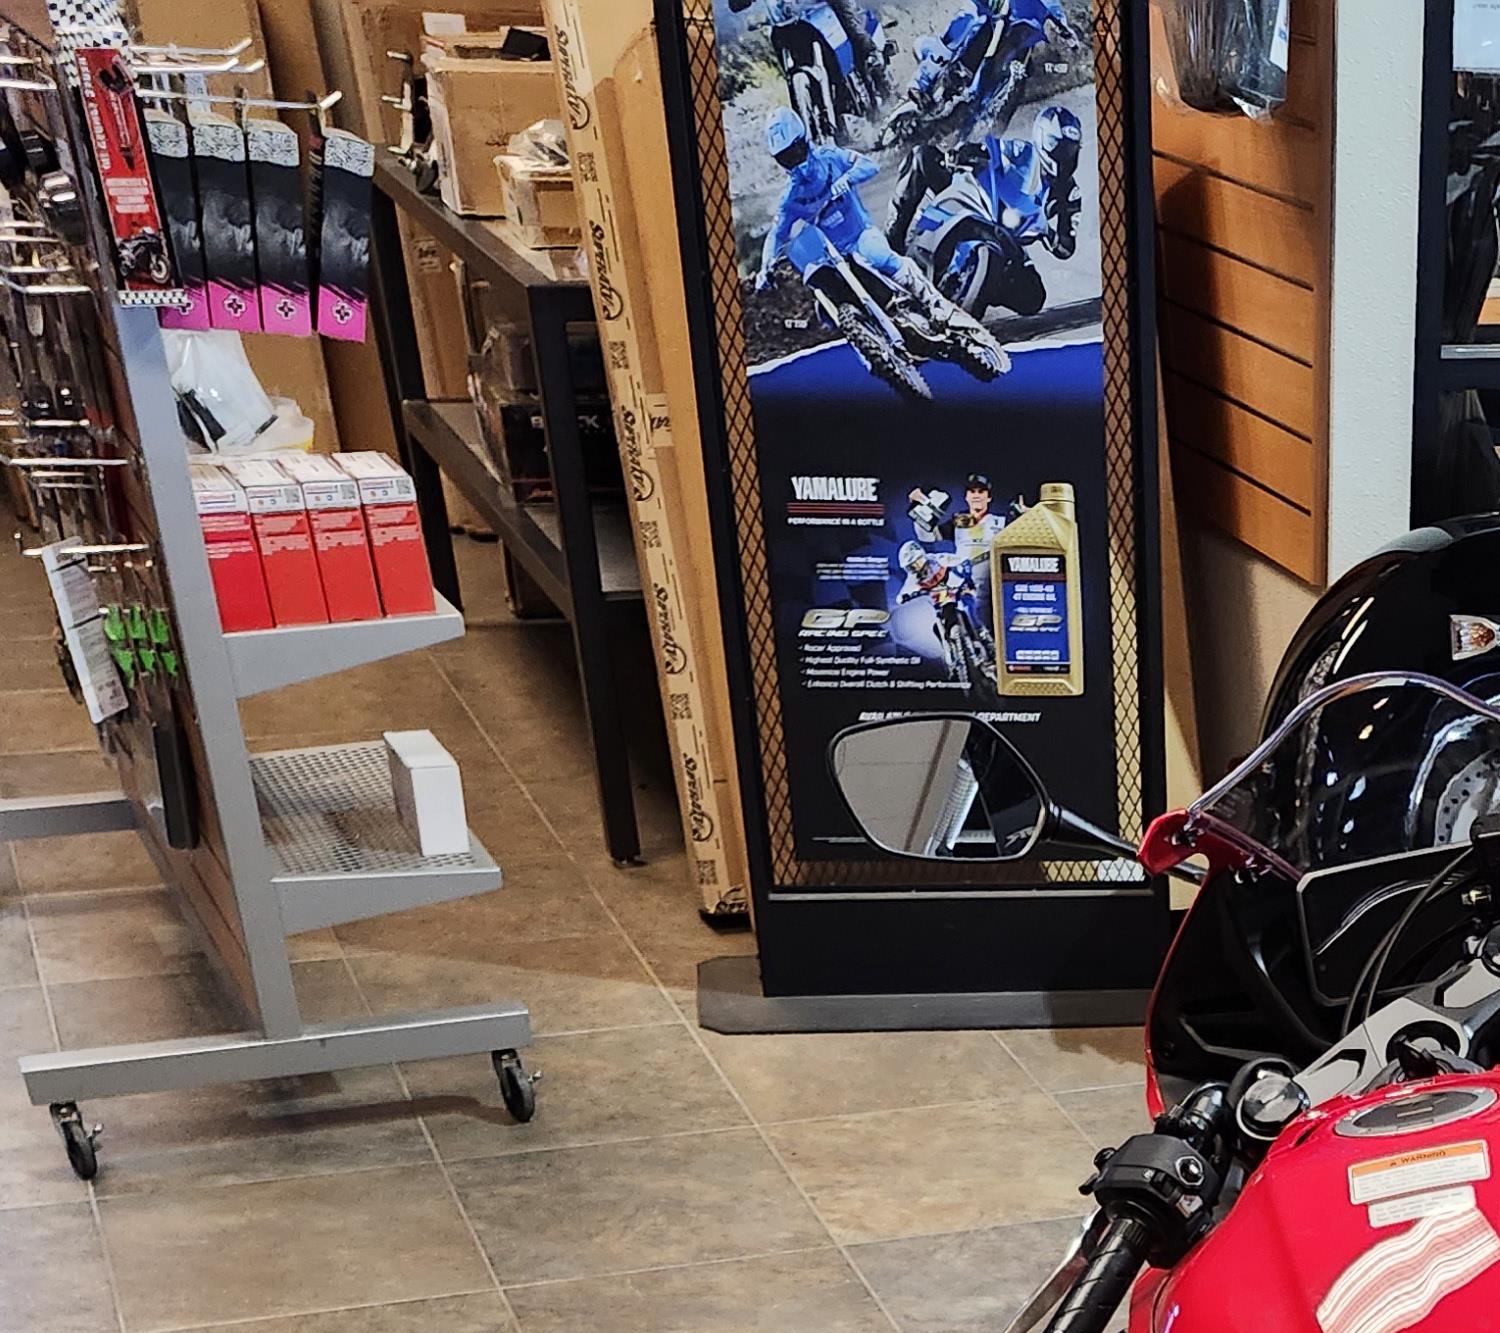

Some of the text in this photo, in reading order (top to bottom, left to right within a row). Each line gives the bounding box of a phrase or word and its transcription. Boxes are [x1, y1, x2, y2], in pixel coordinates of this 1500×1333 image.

[791, 476, 880, 501] YAMALUBE
[1008, 557, 1060, 573] YAMALUBE
[801, 608, 891, 629] GP
[1012, 614, 1063, 627] GP
[798, 629, 889, 637] RACING SPEC
[1400, 1150, 1446, 1164] WARNING
